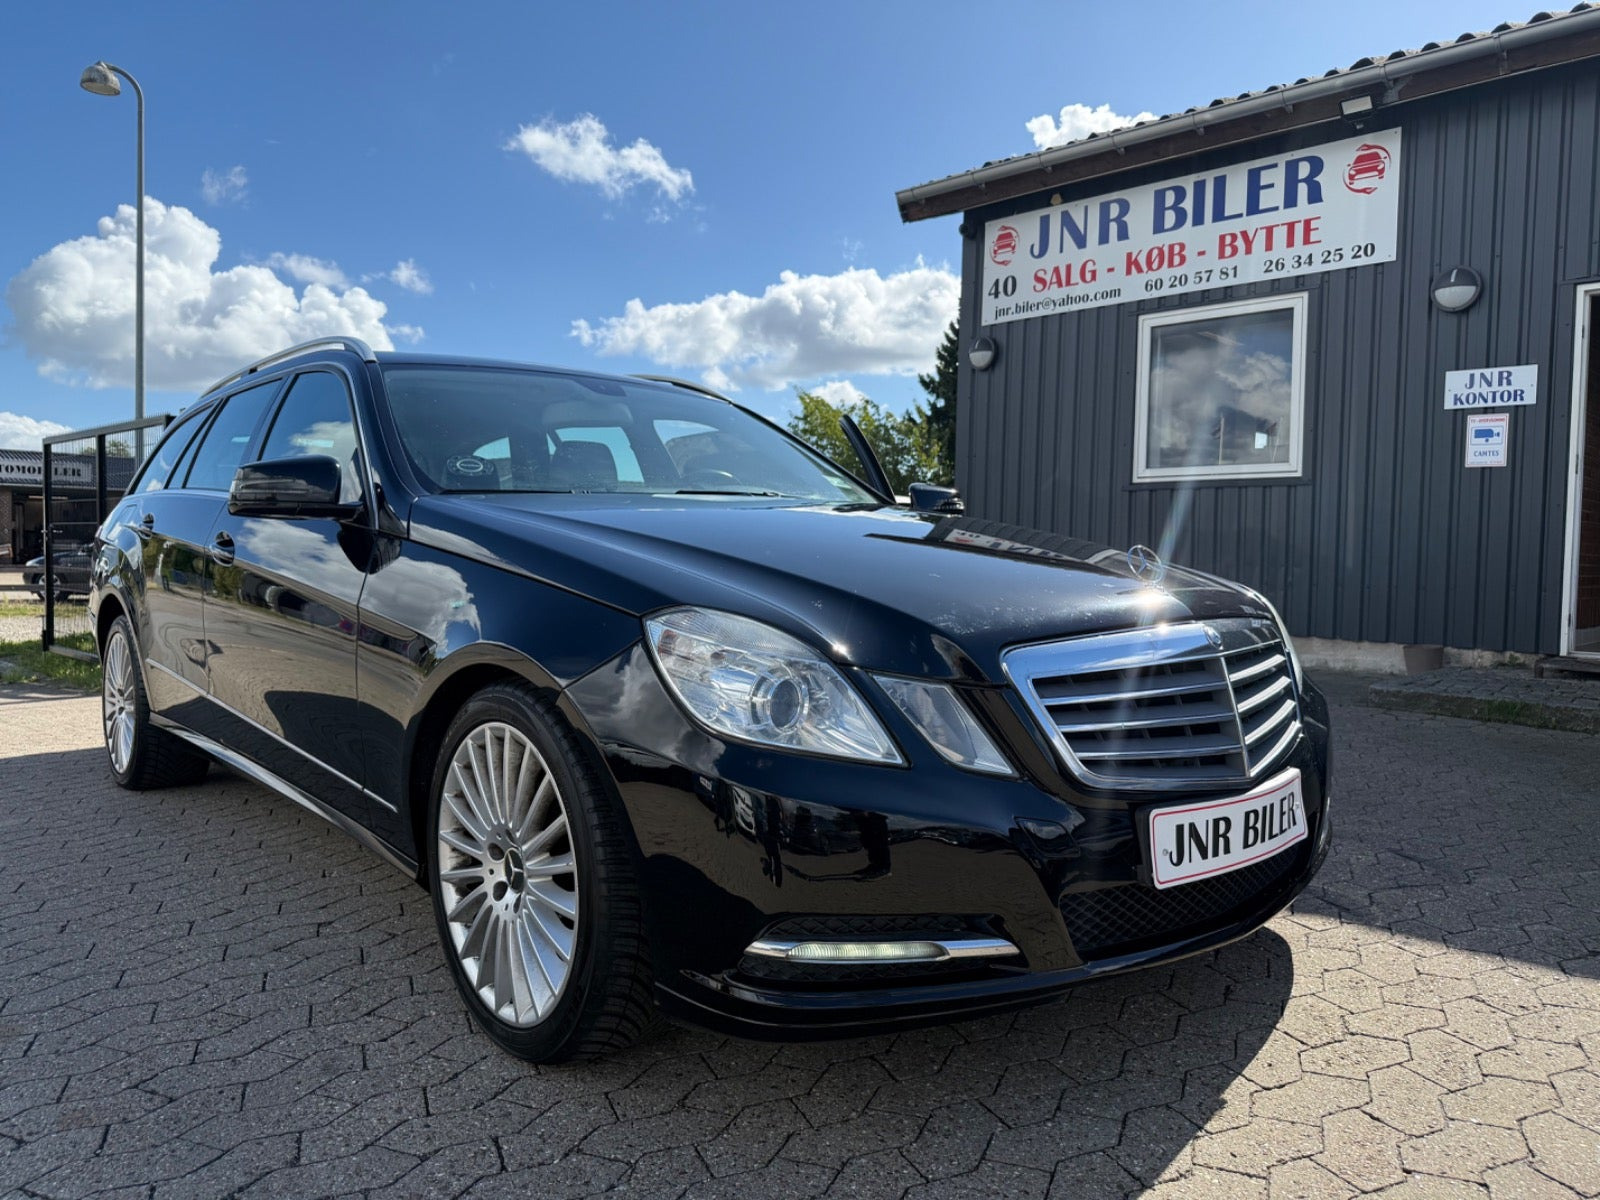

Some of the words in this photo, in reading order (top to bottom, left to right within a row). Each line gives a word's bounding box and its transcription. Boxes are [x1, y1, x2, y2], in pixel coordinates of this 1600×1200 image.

[1030, 198, 1130, 259] JNR
[1153, 155, 1324, 235] BILER
[1033, 259, 1097, 293] SALG
[1125, 241, 1187, 277] KØB
[1218, 216, 1322, 260] BYTTE
[1263, 257, 1285, 273] 26
[1292, 253, 1313, 269] 34
[1321, 247, 1344, 264] 25
[1351, 242, 1376, 260] 20
[988, 275, 1017, 299] 40
[1145, 277, 1164, 293] 60
[1168, 273, 1188, 289] 20
[1193, 269, 1213, 285] 57
[1219, 265, 1238, 281] 81
[994, 288, 1122, 320] jnr.biler@yahoo.com
[1465, 370, 1512, 388] JNR
[1453, 388, 1525, 405] KONTOR
[1169, 816, 1232, 867] JNR
[1242, 791, 1297, 850] BILER
